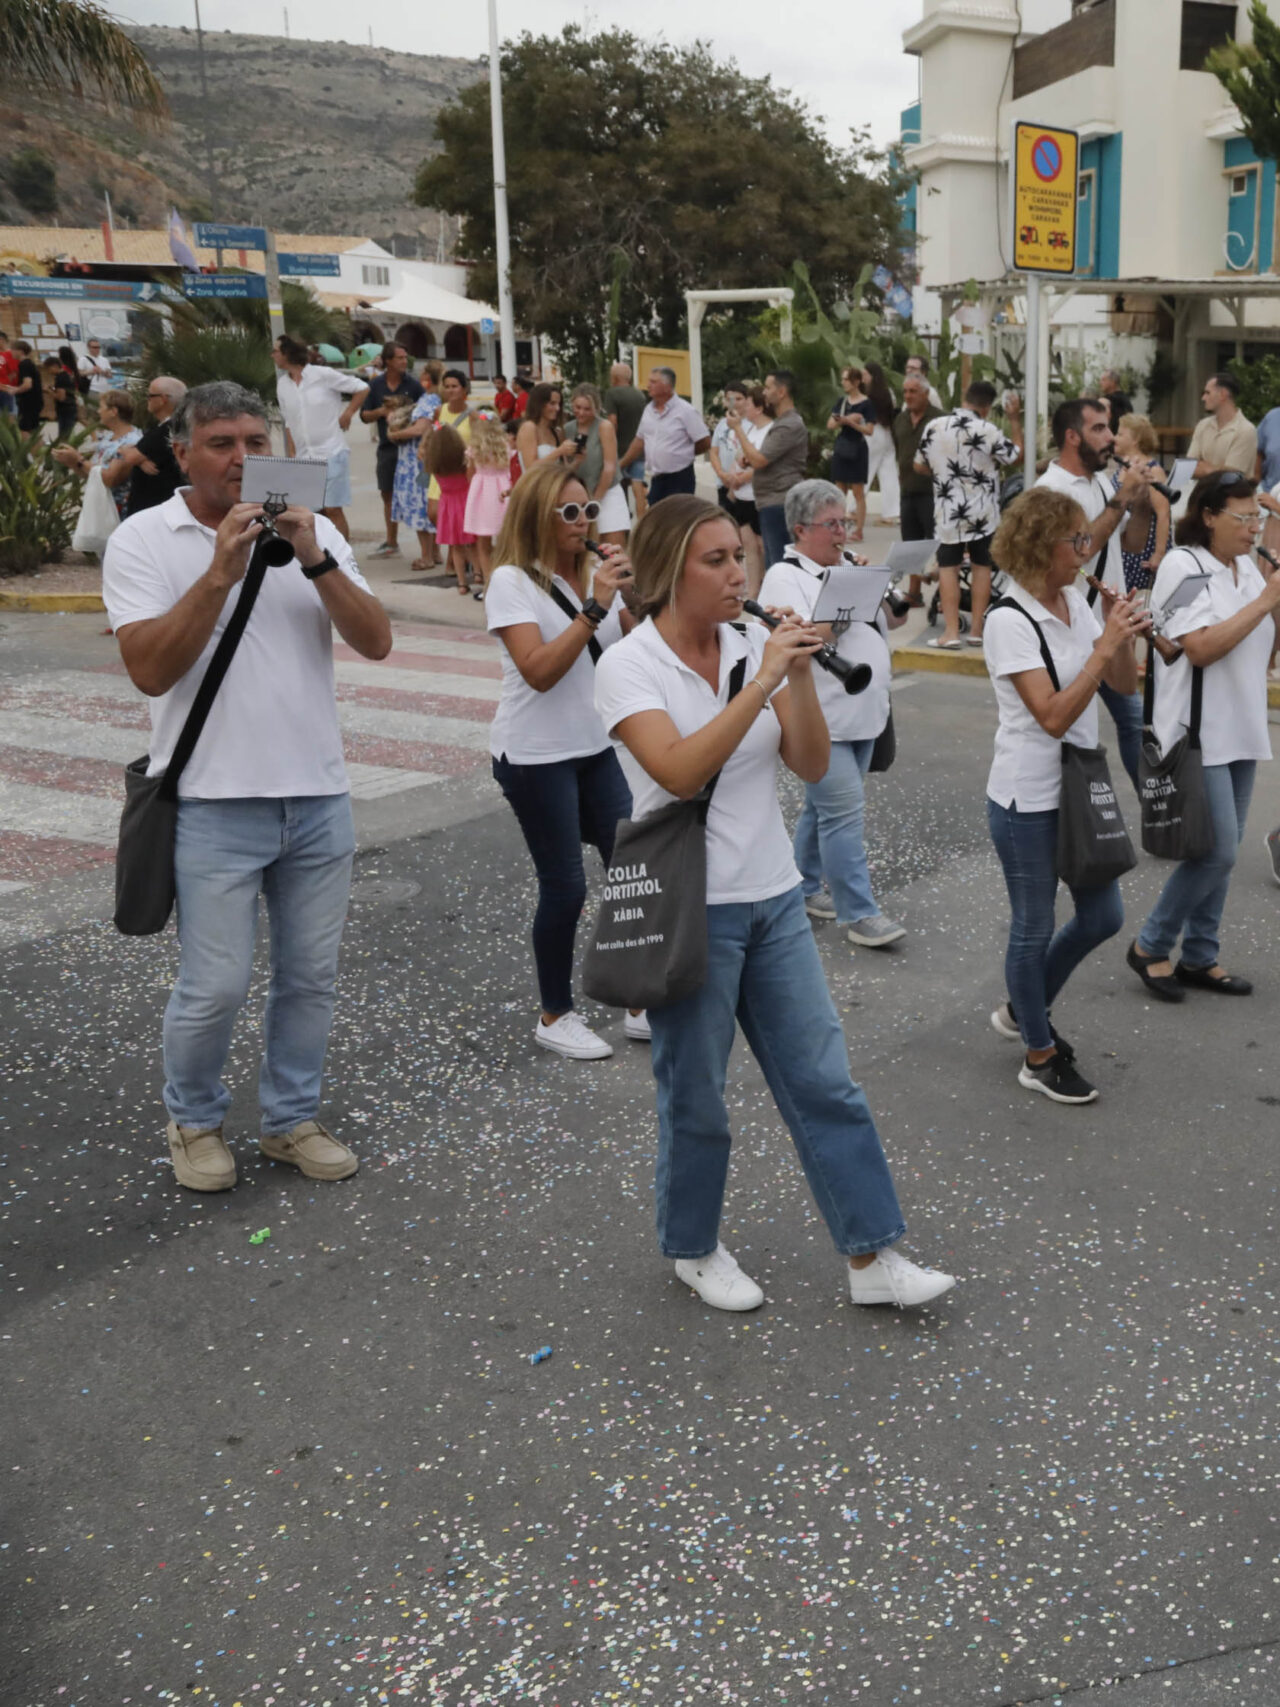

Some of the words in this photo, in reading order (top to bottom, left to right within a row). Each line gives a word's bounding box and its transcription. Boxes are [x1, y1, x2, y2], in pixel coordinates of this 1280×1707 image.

[608, 863, 647, 883] COLLA
[613, 906, 645, 923] XÀBIA
[647, 933, 664, 945] 1999
